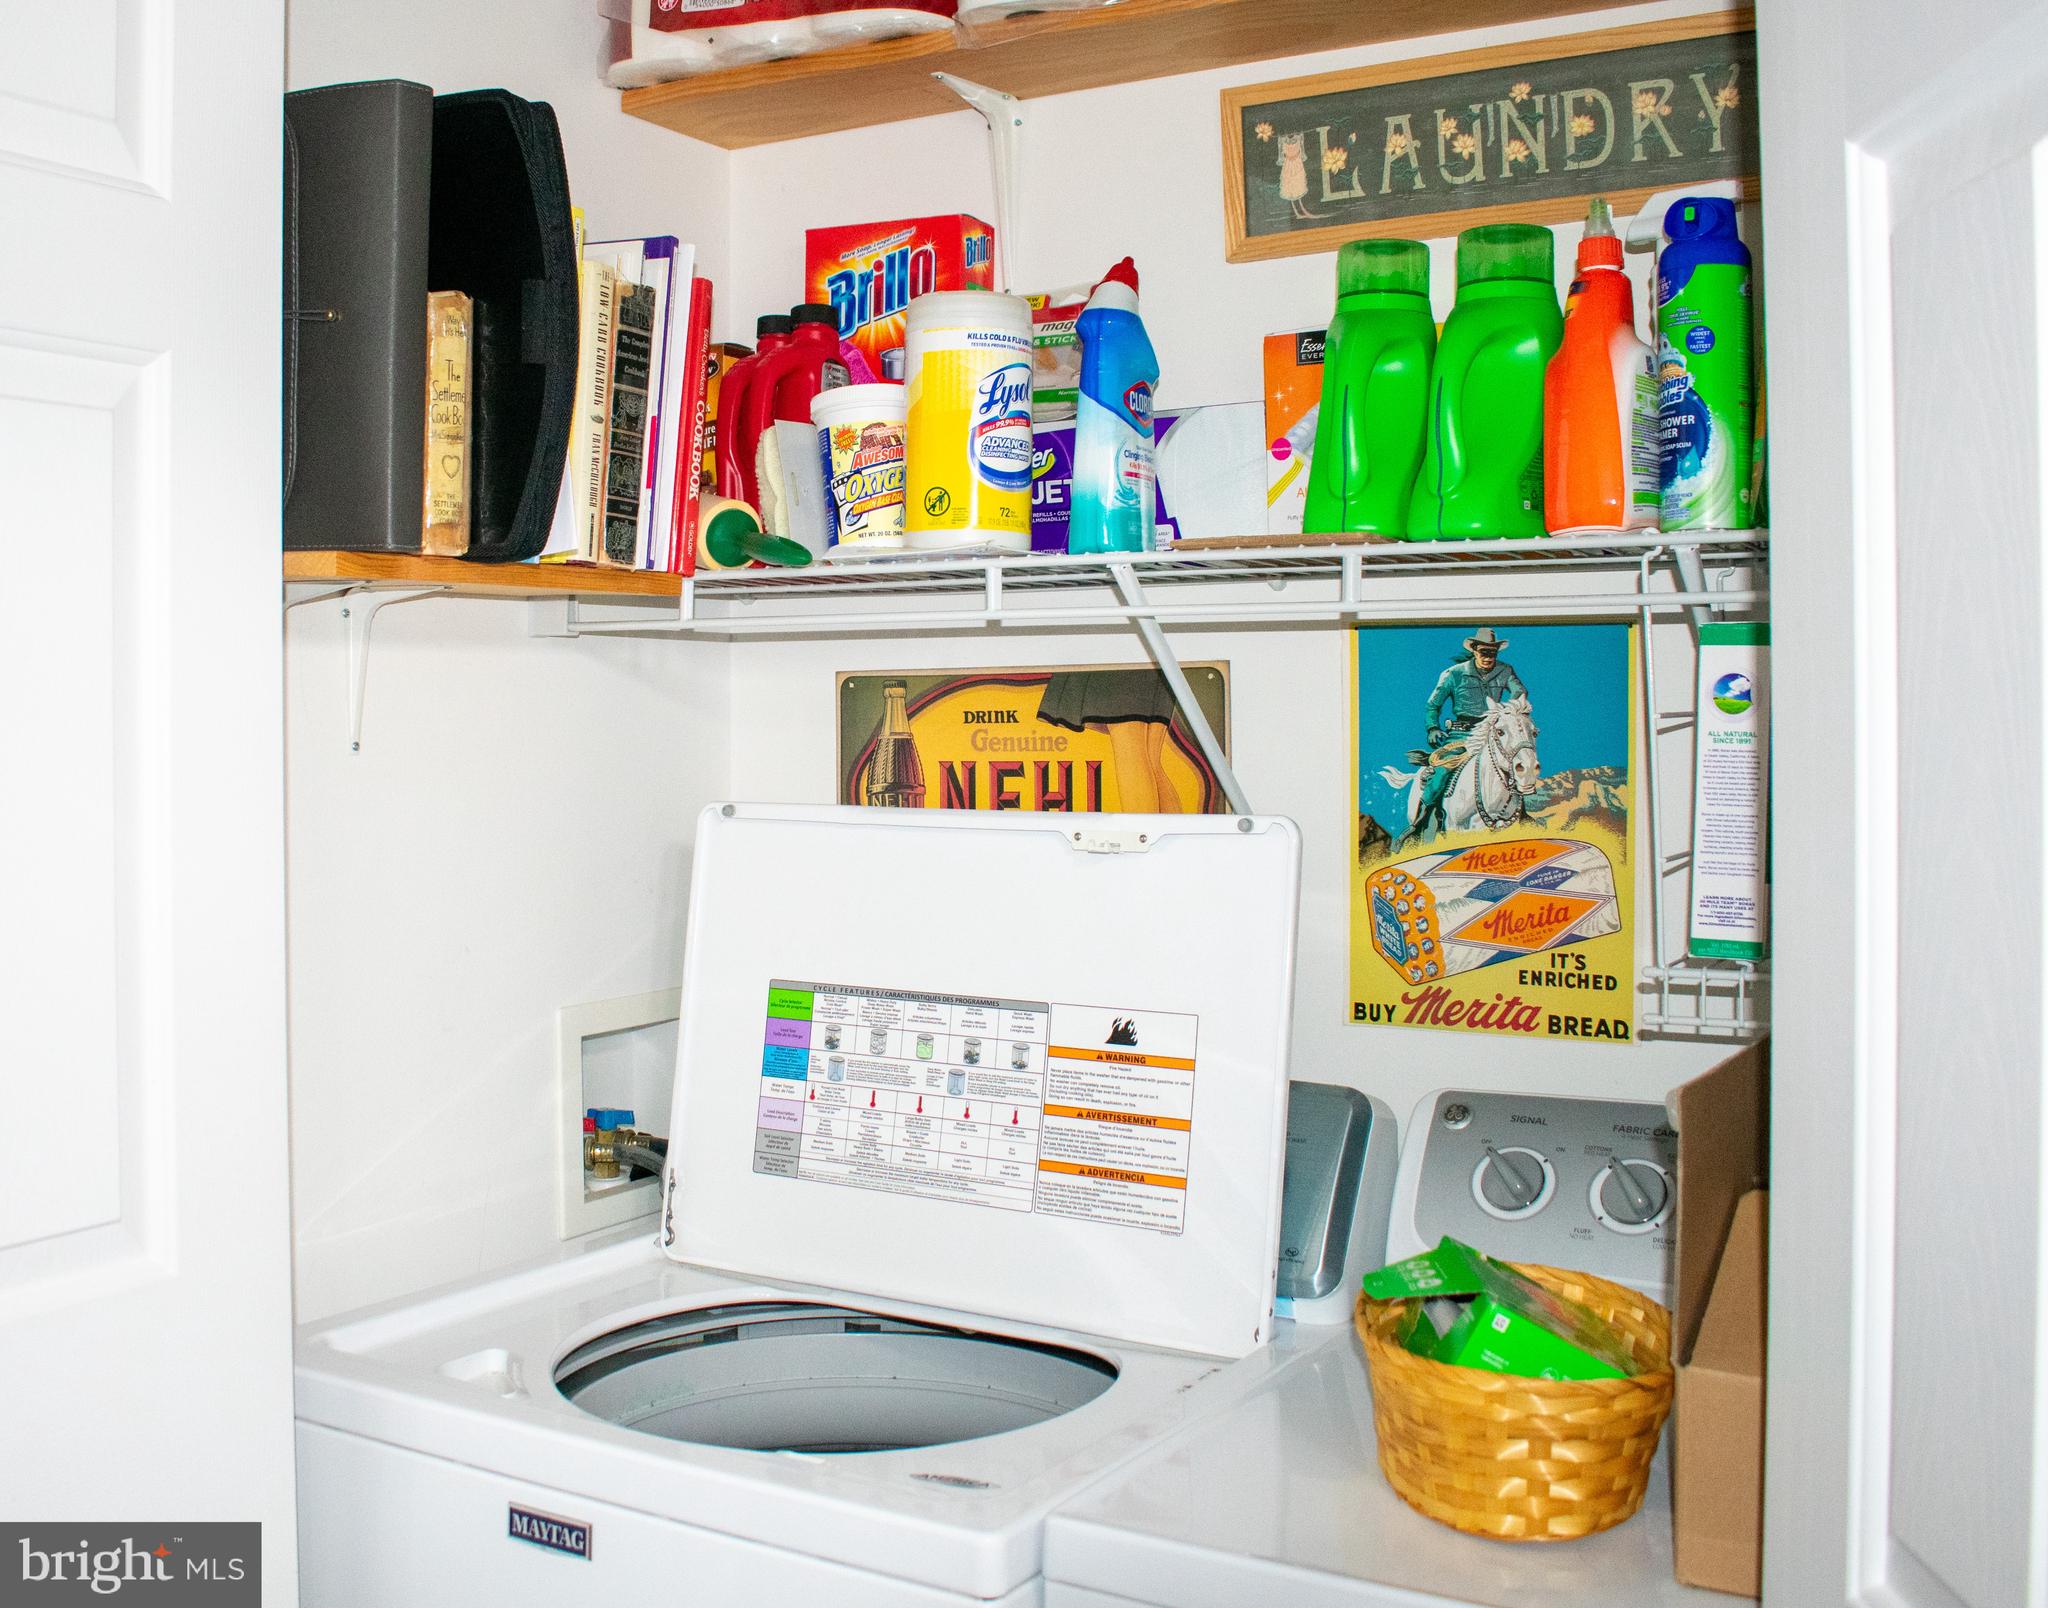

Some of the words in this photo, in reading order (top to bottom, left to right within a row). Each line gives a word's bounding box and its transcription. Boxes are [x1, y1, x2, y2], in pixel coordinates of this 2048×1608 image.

[1317, 63, 1742, 202] LAUNDRY
[965, 234, 991, 268] Brillo
[828, 248, 936, 337] Brillo
[968, 332, 988, 340] KILLS
[989, 334, 1006, 342] COLD
[446, 359, 461, 382] The
[594, 349, 607, 407] COOKBOOK
[979, 373, 1032, 416] Lysol
[689, 400, 705, 502] COOKBOOK
[853, 446, 904, 469] AWESOM
[981, 451, 1018, 460] DISINFECTING
[845, 466, 903, 503] OXYGE
[999, 507, 1011, 518] 72
[963, 710, 1019, 725] DRINK
[970, 729, 1068, 753] Genuine
[938, 760, 1103, 812] NEHI
[1462, 847, 1537, 871] Merita
[1526, 877, 1543, 887] LONE
[1543, 870, 1572, 882] RANGER
[1483, 903, 1570, 939] Merita
[1551, 952, 1587, 970] IT'S
[1518, 969, 1618, 991] ENRICHED
[813, 985, 836, 993] CYCLE
[840, 987, 880, 996] FEATURES
[885, 991, 941, 1001] CARACTÉRISTIQUES
[955, 997, 1000, 1007] PROGRAMMES
[1353, 1002, 1396, 1023] BUY
[1401, 985, 1543, 1032] Merita
[1548, 1014, 1630, 1040] BREAD
[1105, 1053, 1145, 1063] WARNING
[1085, 1111, 1157, 1126] AVERTISSEMENT
[1510, 1114, 1548, 1126] SIGNAL
[1612, 1124, 1650, 1136] FABRIC
[1087, 1168, 1145, 1182] ADVERTENCIA
[511, 1511, 586, 1551] MAYTAG
